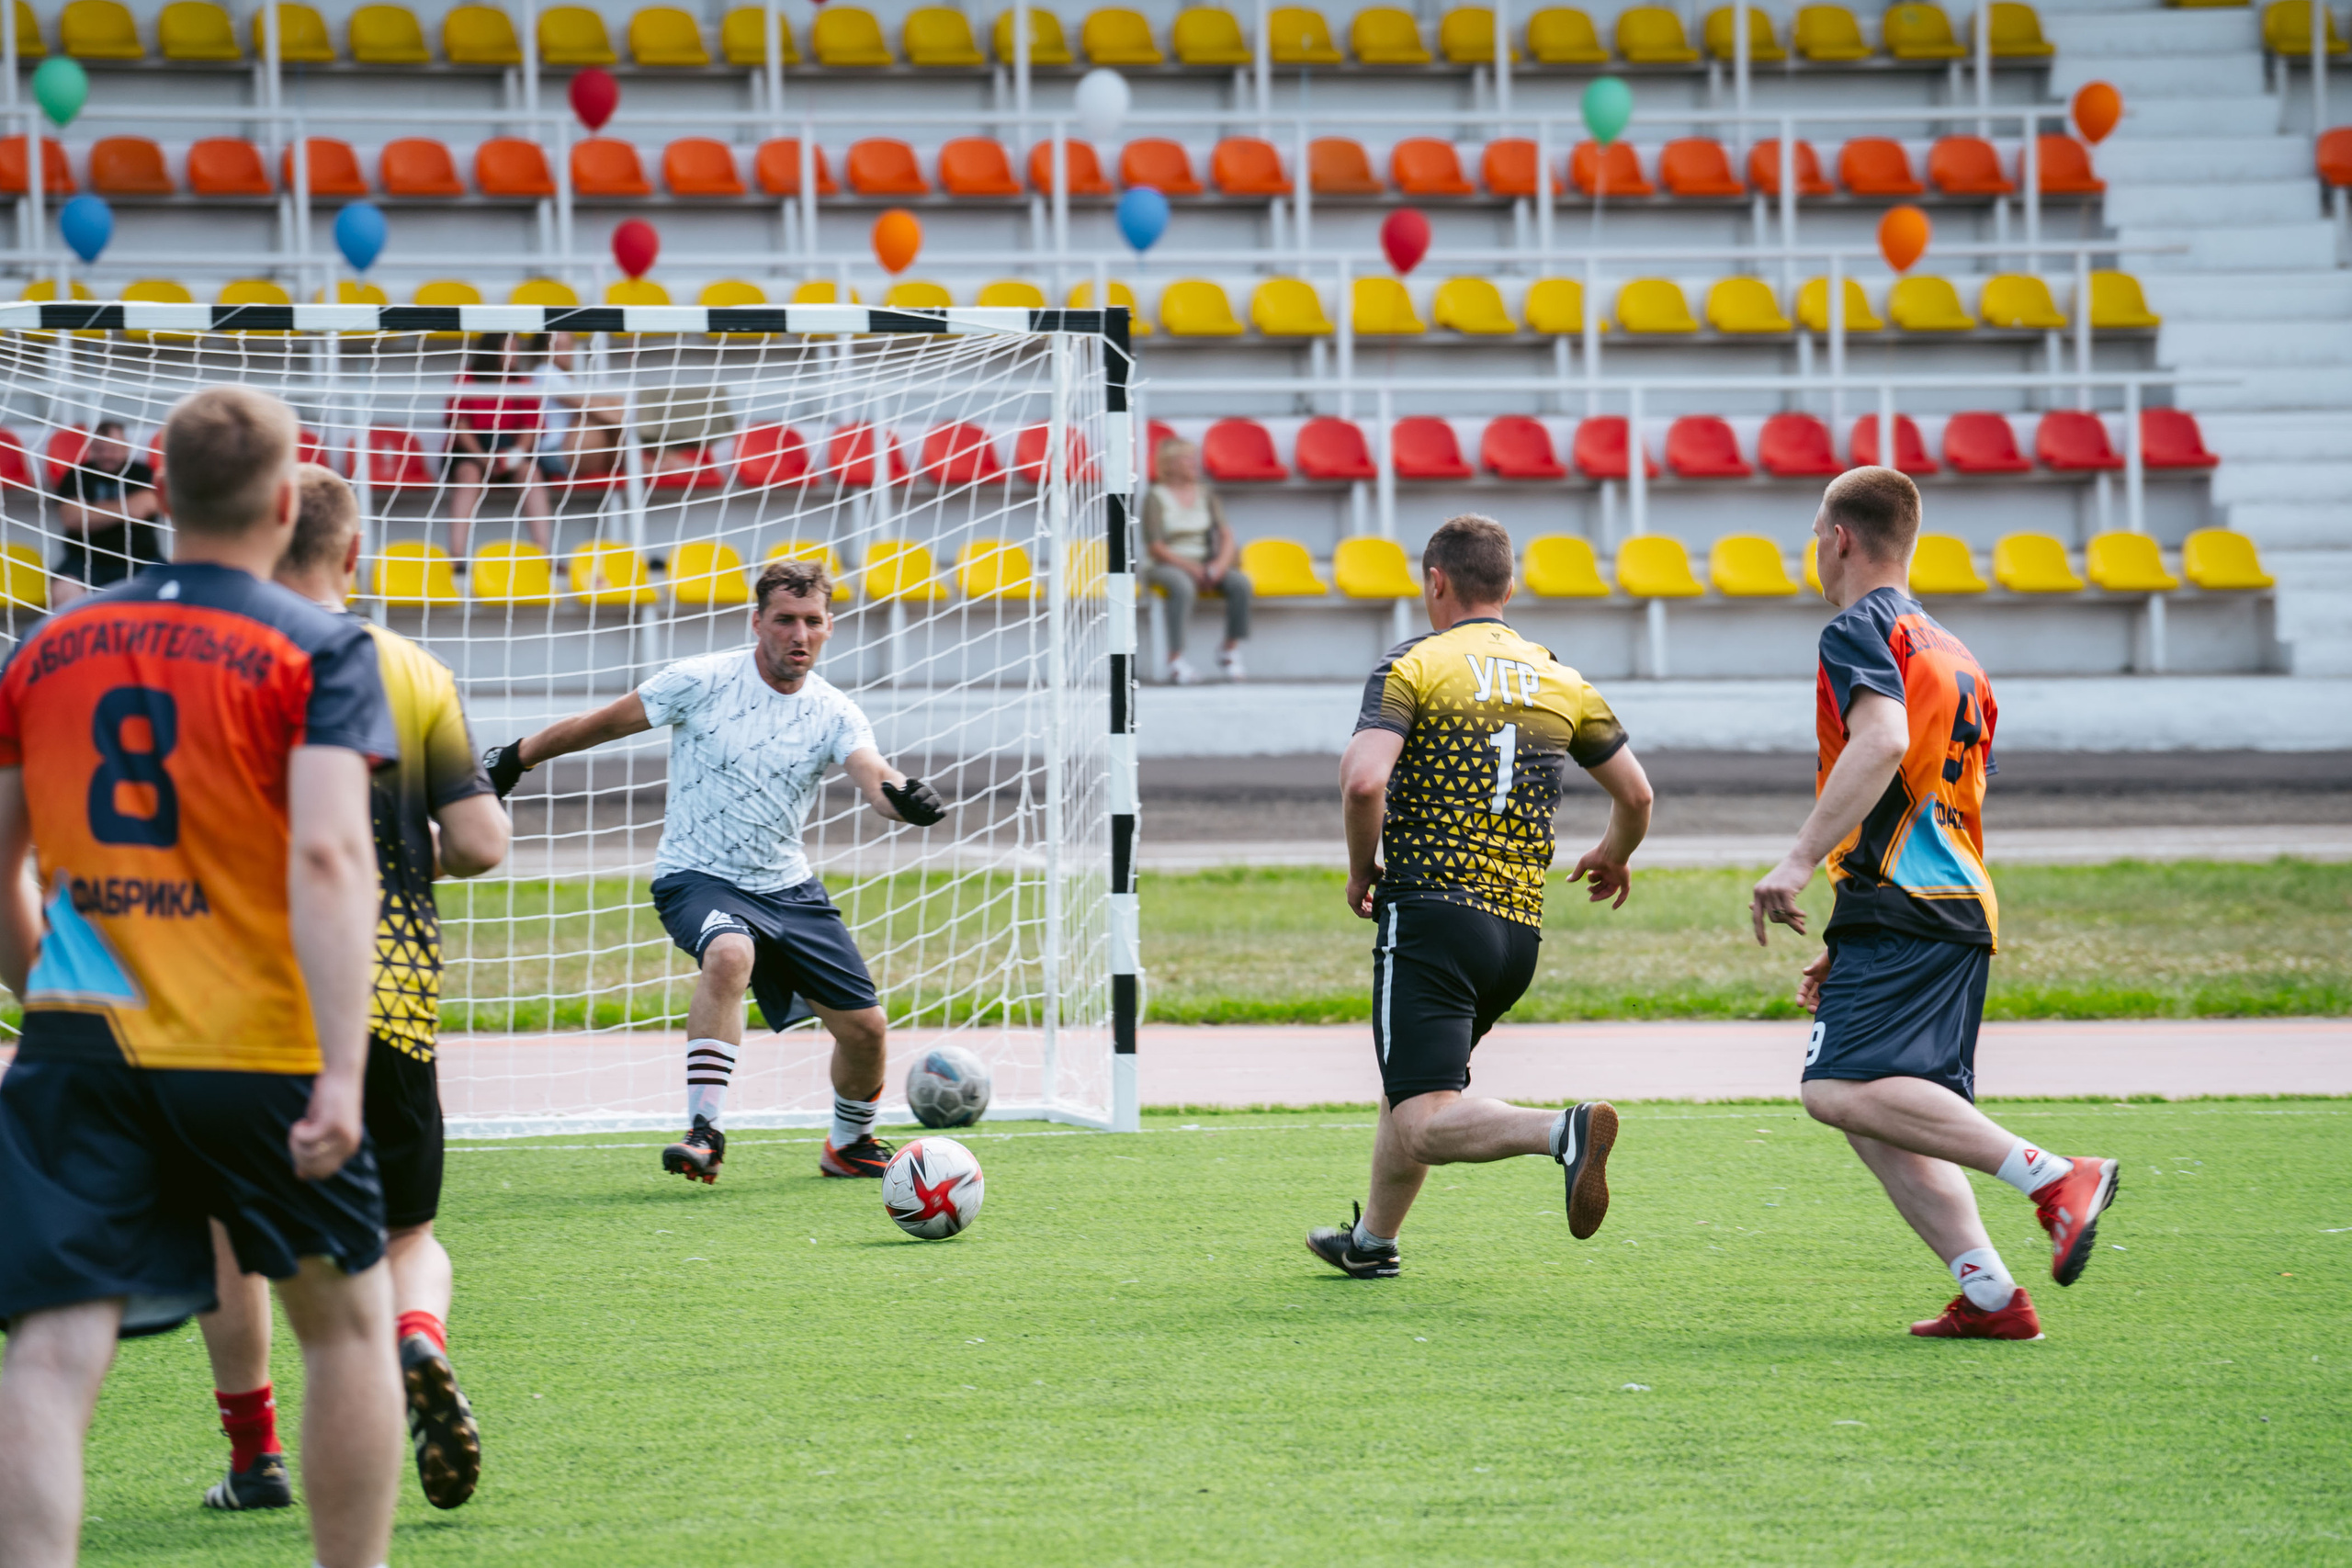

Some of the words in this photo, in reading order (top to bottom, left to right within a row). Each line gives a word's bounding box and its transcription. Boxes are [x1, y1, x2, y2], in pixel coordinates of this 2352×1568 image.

[1464, 653, 1541, 708] УГР
[728, 708, 747, 721] NIKE
[87, 685, 179, 850] 8
[748, 738, 767, 751] NIKE
[1488, 722, 1517, 816] 1
[1804, 1021, 1826, 1067] 9
